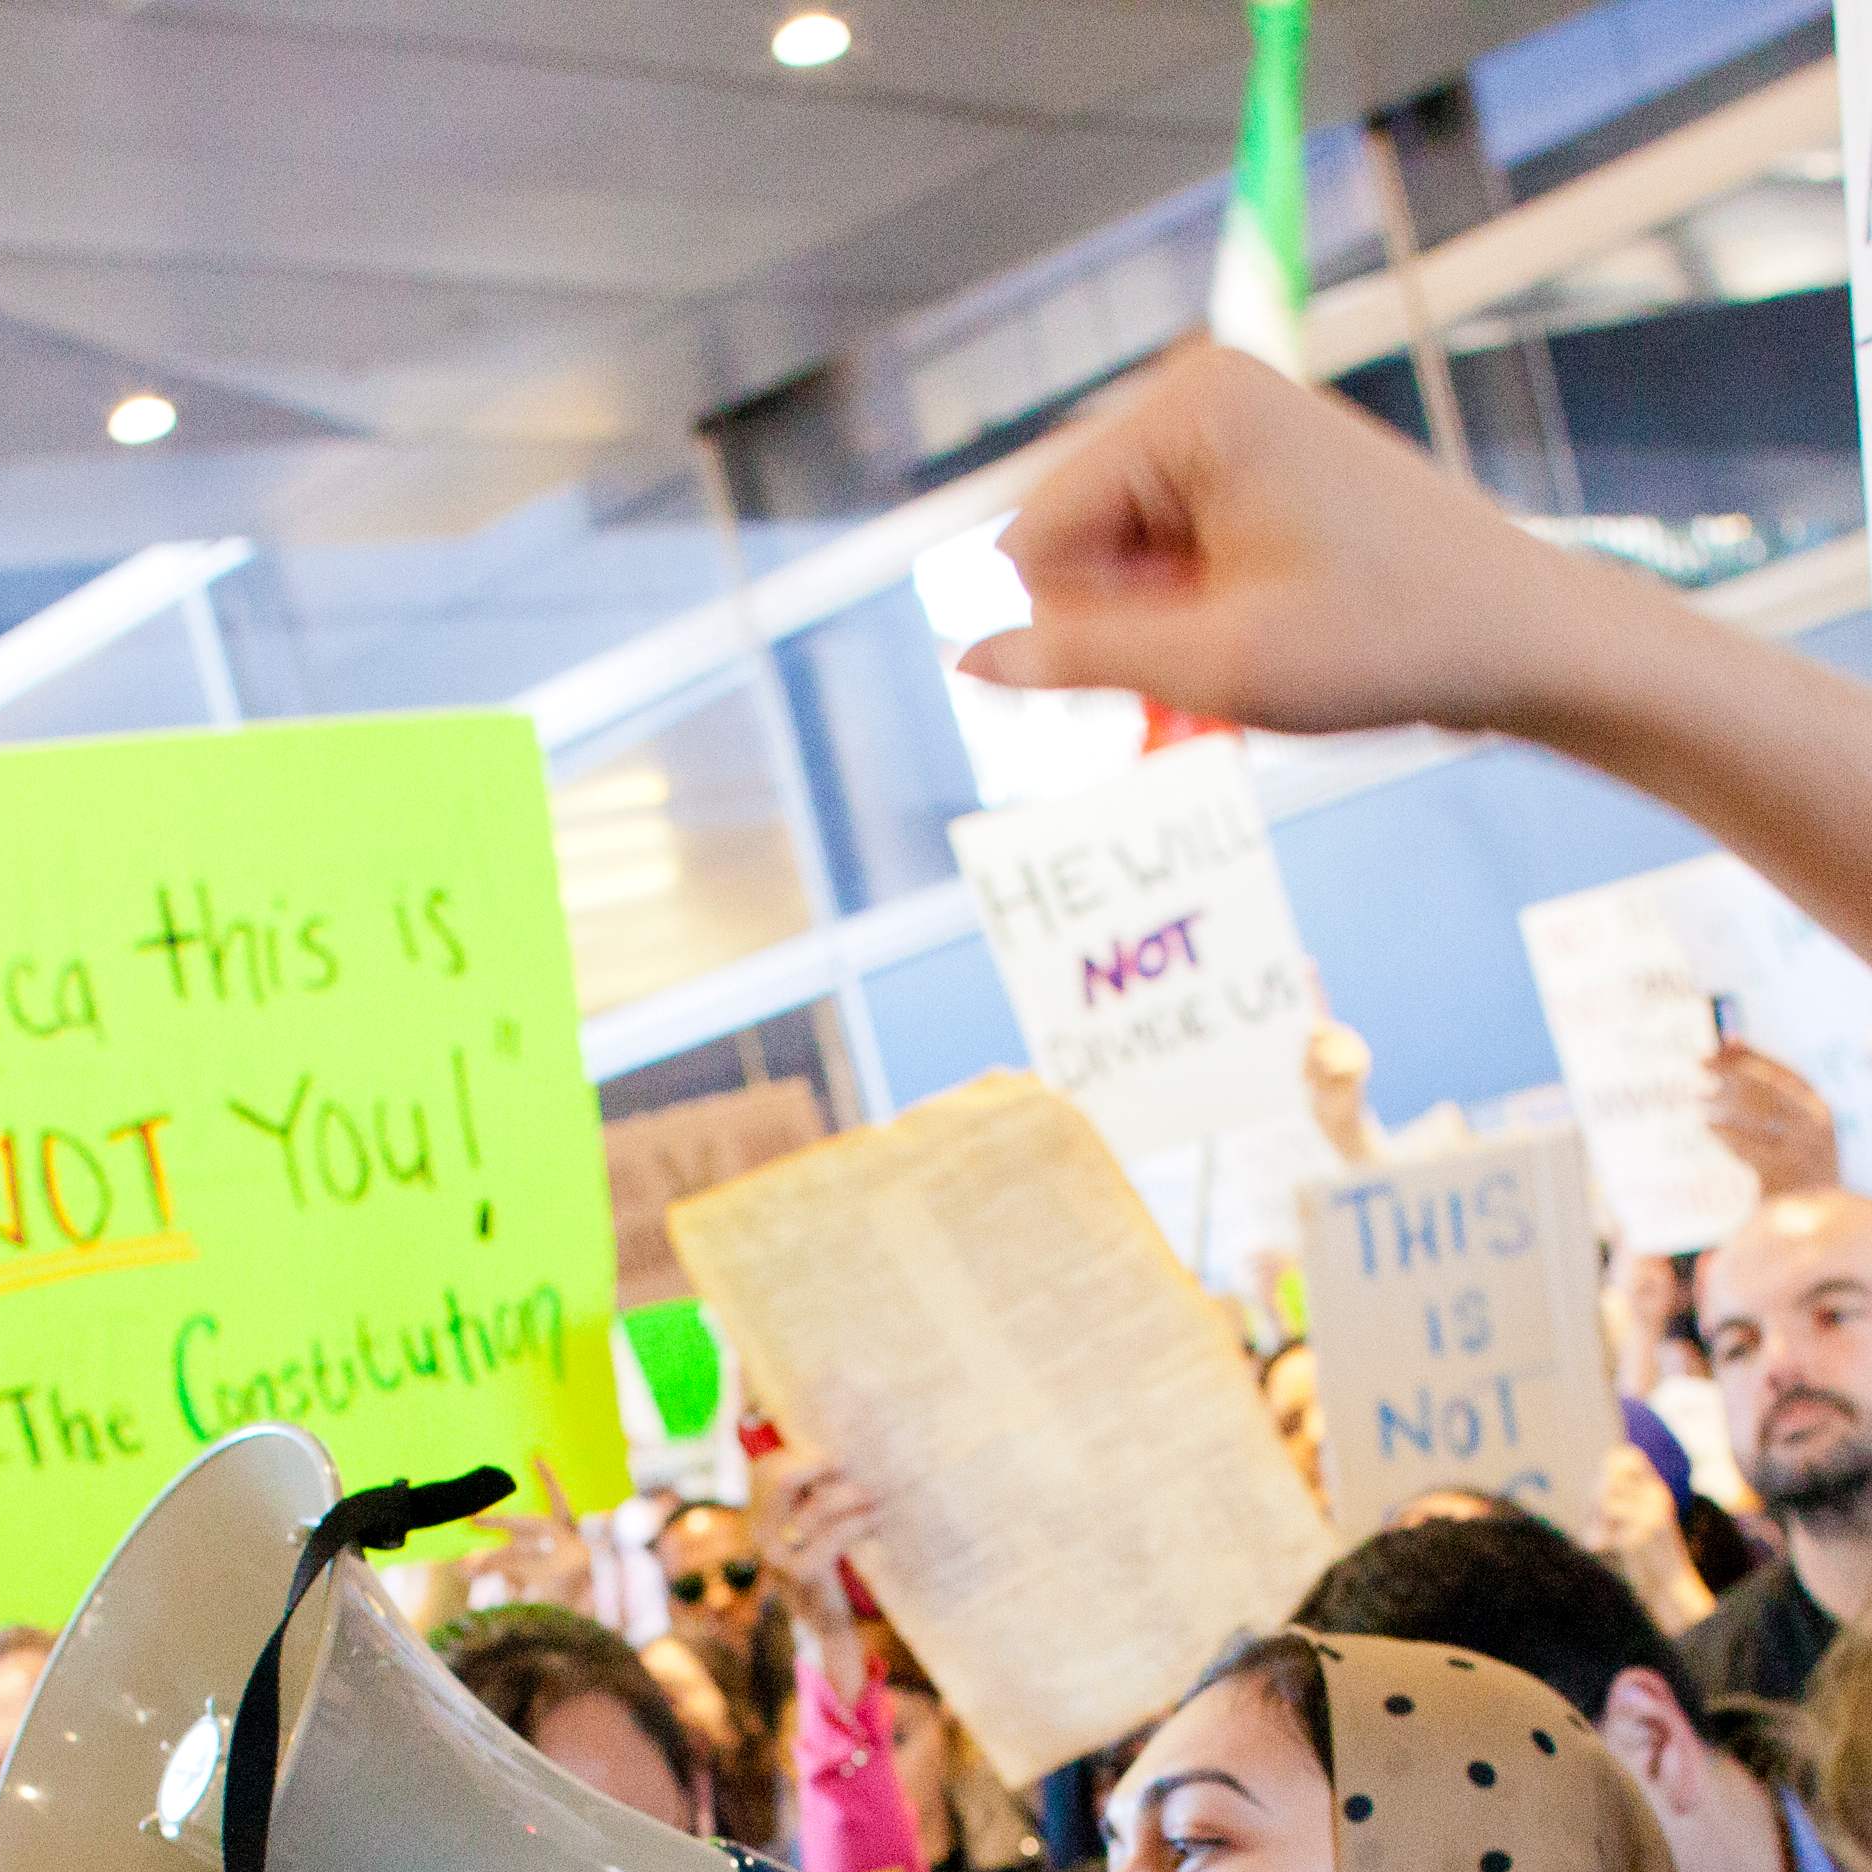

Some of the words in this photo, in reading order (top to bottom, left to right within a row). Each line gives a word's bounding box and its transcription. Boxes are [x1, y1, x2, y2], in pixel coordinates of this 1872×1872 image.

[132, 880, 340, 1006] this
[394, 882, 468, 978] is
[1078, 905, 1210, 1010] NOT
[1331, 1168, 1536, 1282] THIS
